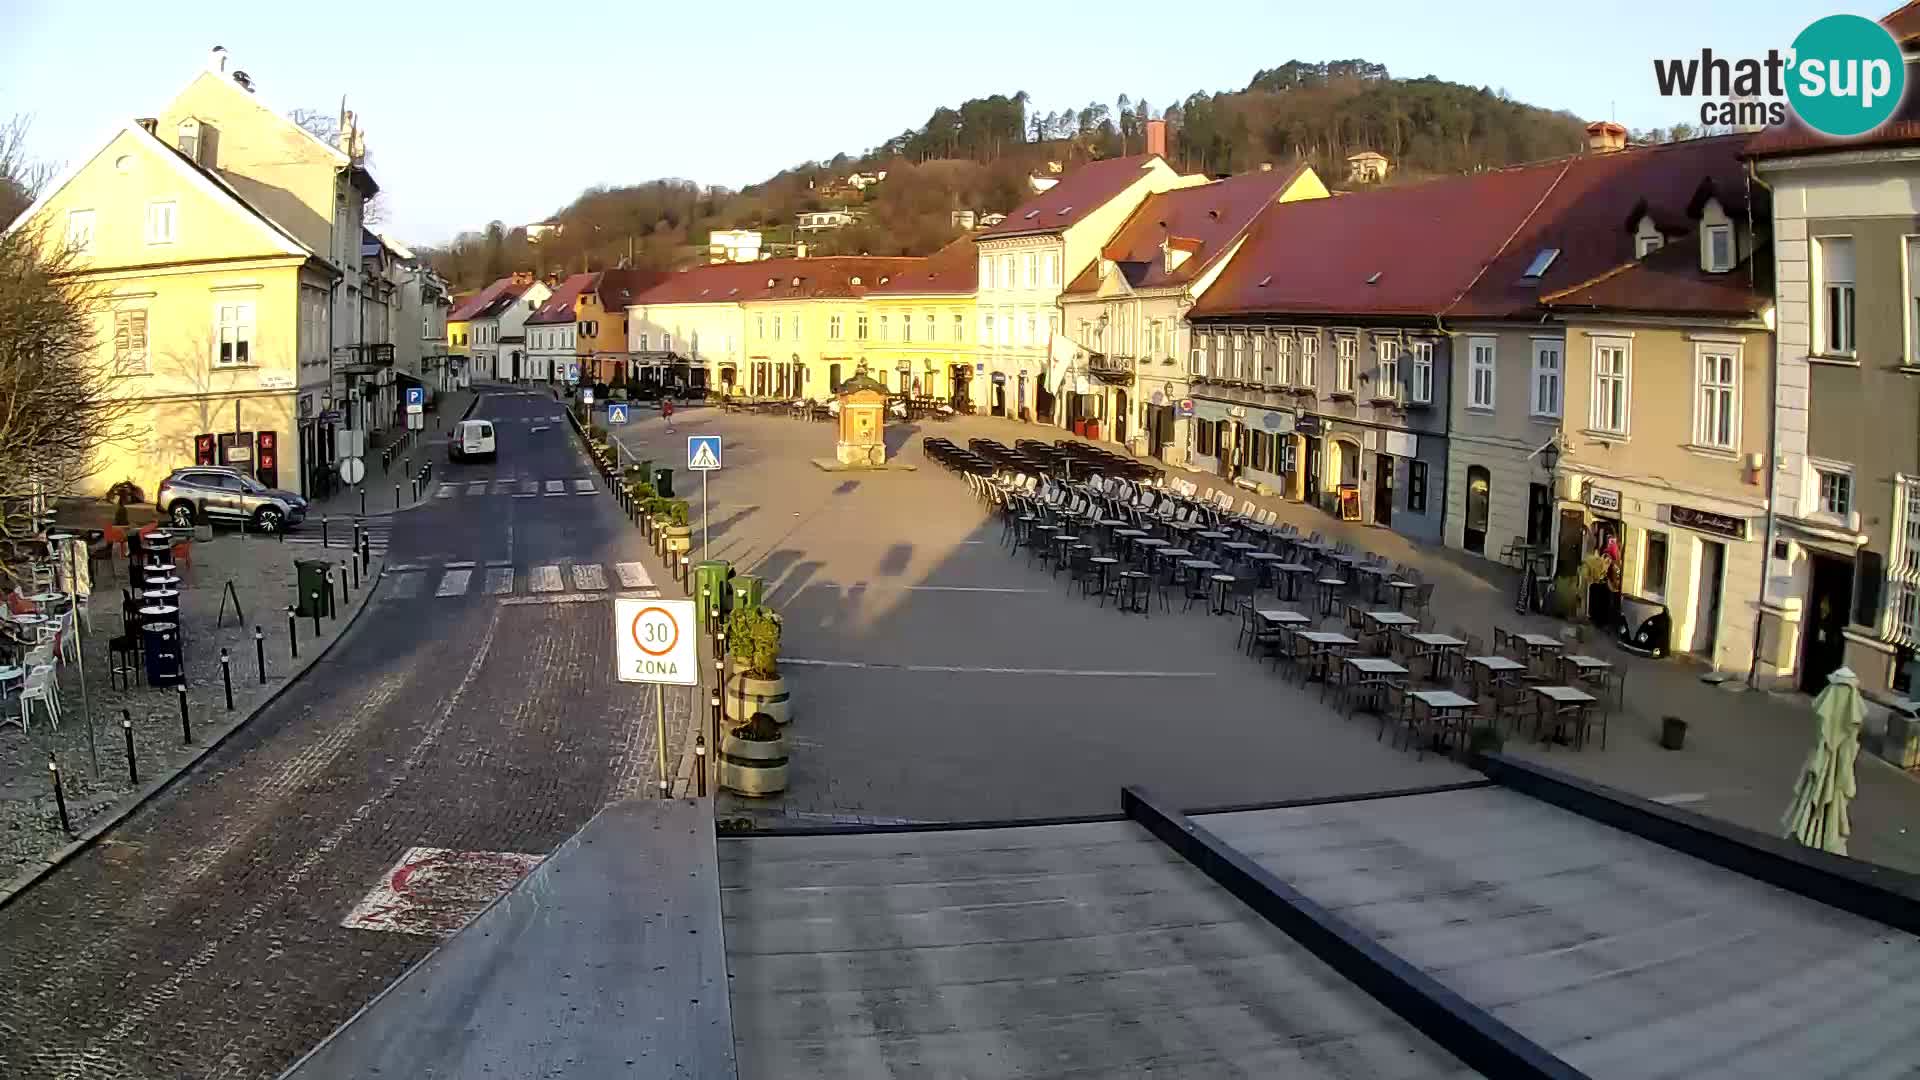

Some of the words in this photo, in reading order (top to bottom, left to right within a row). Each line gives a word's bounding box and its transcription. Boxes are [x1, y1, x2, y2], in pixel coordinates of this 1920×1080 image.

[410, 391, 419, 402] P
[645, 622, 668, 643] 30
[635, 659, 678, 675] ZONA
